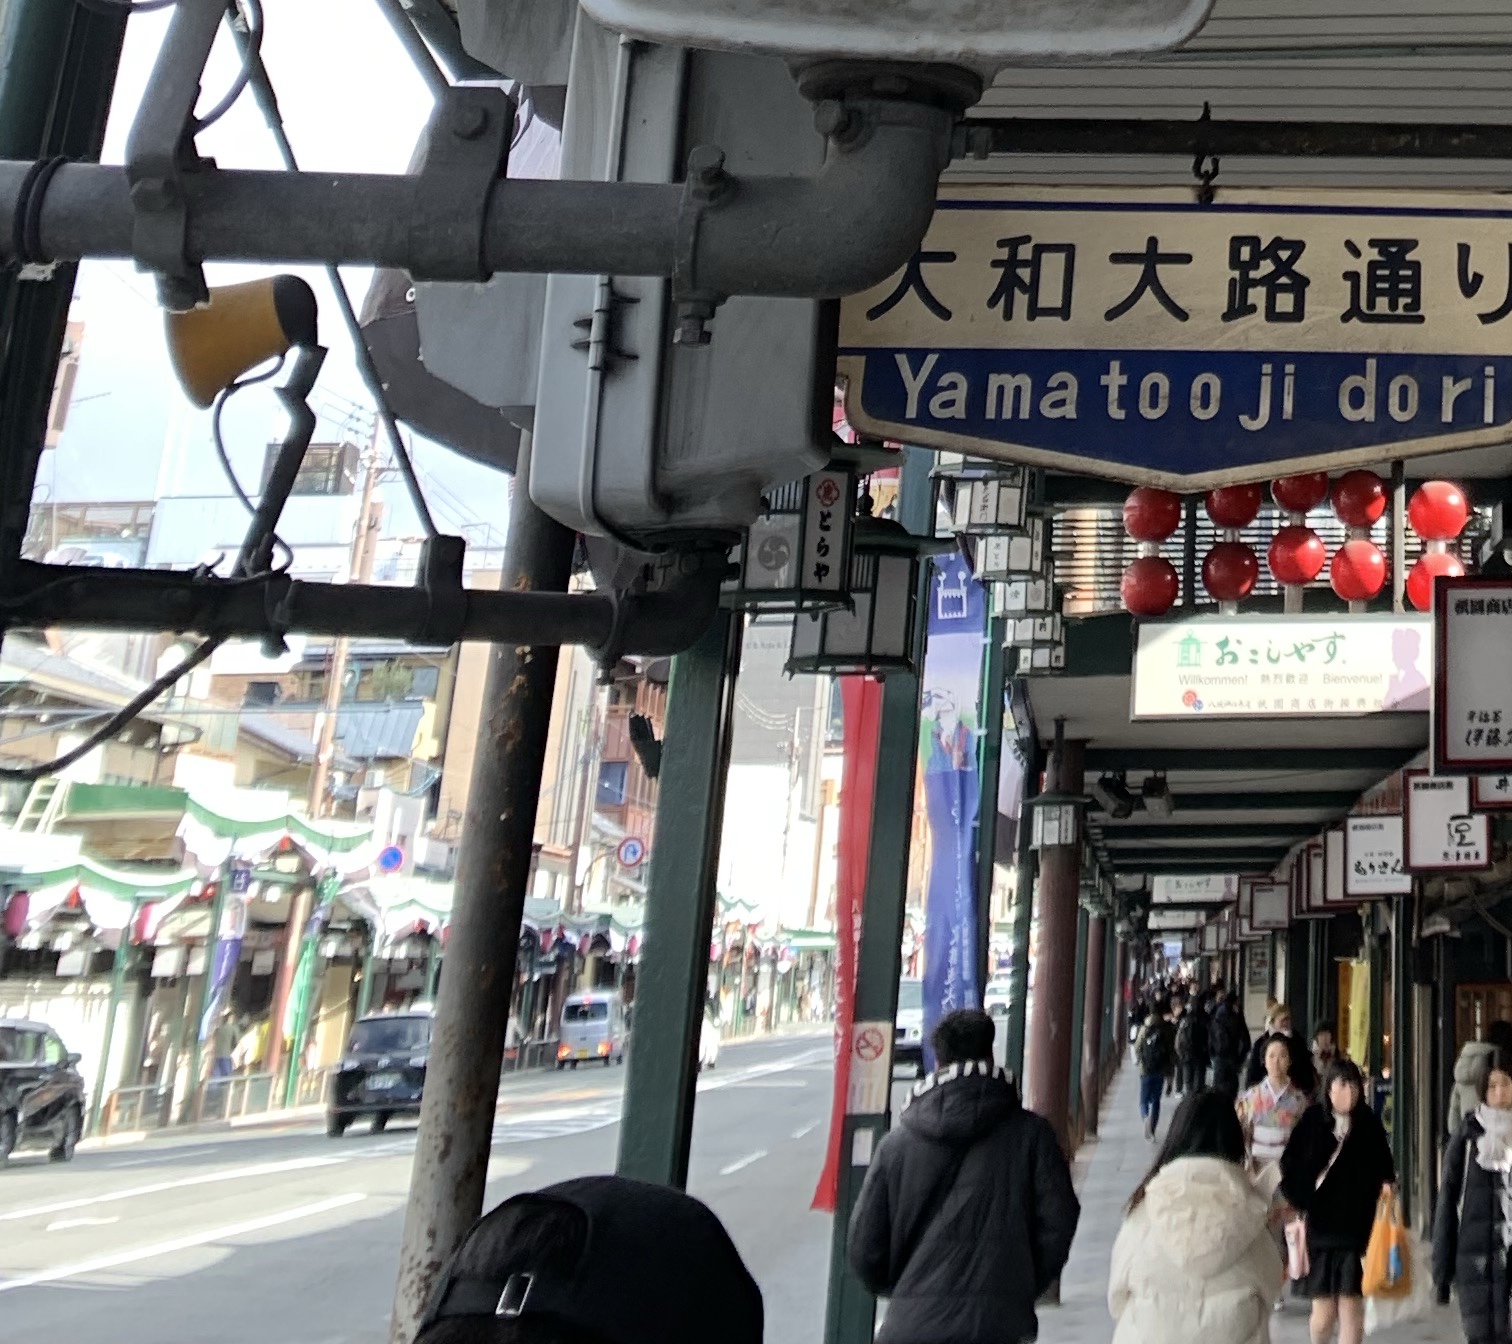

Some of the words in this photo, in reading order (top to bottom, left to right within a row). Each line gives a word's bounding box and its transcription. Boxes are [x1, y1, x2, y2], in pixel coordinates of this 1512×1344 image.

[1337, 357, 1498, 425] dori
[813, 510, 833, 584] とらや
[1177, 672, 1249, 687] Willkommen!
[1321, 672, 1384, 686] Bienvenue!
